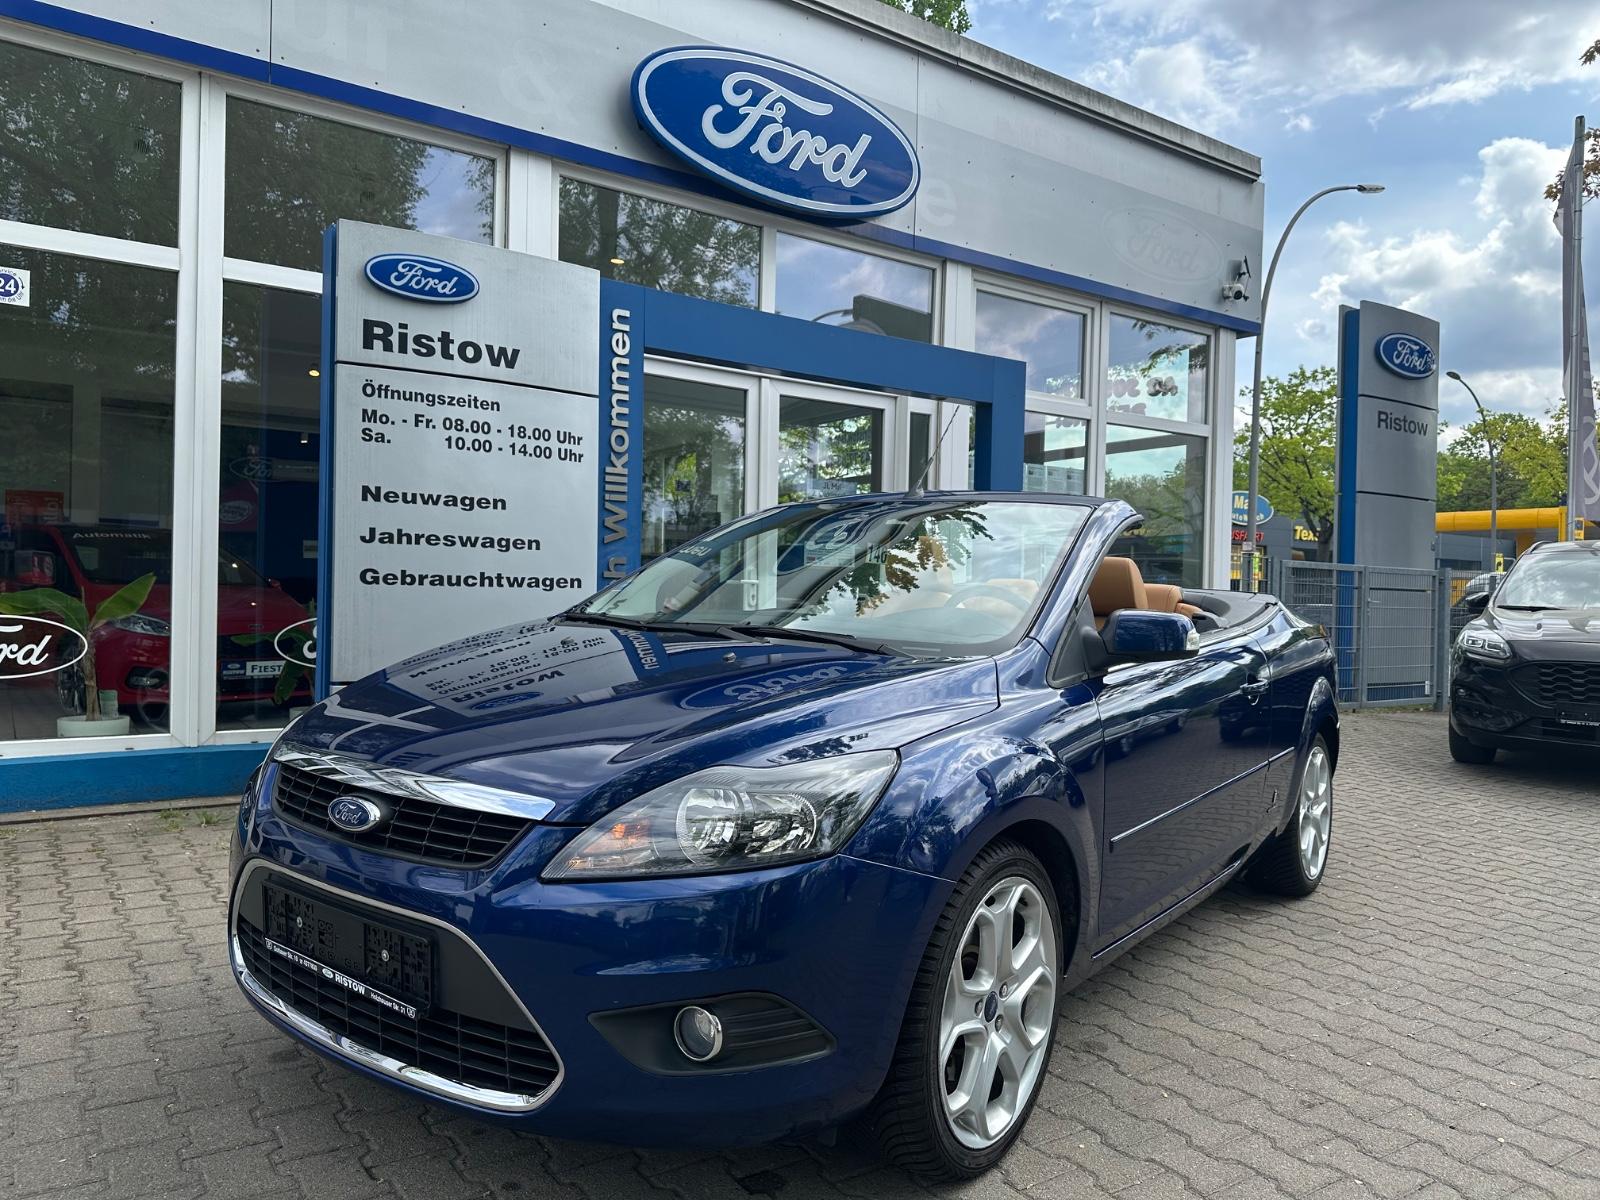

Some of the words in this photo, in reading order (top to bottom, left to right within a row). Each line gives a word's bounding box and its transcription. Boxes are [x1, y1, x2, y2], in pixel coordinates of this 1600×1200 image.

[702, 72, 872, 187] Ford
[390, 261, 458, 295] Ford
[363, 319, 520, 369] Ristow
[1393, 339, 1428, 371] Ford
[362, 378, 500, 411] Öffnungszeiten
[362, 408, 395, 425] Mo.
[414, 413, 436, 429] Fr.
[442, 417, 491, 435] 08.00
[508, 424, 551, 442] 18.00
[557, 430, 583, 446] Uhr
[604, 308, 631, 544] Willkommen
[1377, 410, 1428, 436] Ristow
[361, 427, 391, 444] Sa.
[445, 435, 492, 453] 10.00
[509, 442, 552, 459] 14.00
[557, 447, 584, 463] Uhr
[361, 485, 506, 511] Neuwagen
[73, 531, 152, 541] Automatik
[359, 527, 541, 552] Jahreswagen
[359, 568, 582, 592] Gebrauchtwagen
[0, 624, 52, 665] rd
[251, 664, 283, 674] FIEST
[335, 801, 362, 824] Ford
[335, 973, 365, 995] RISTOW
